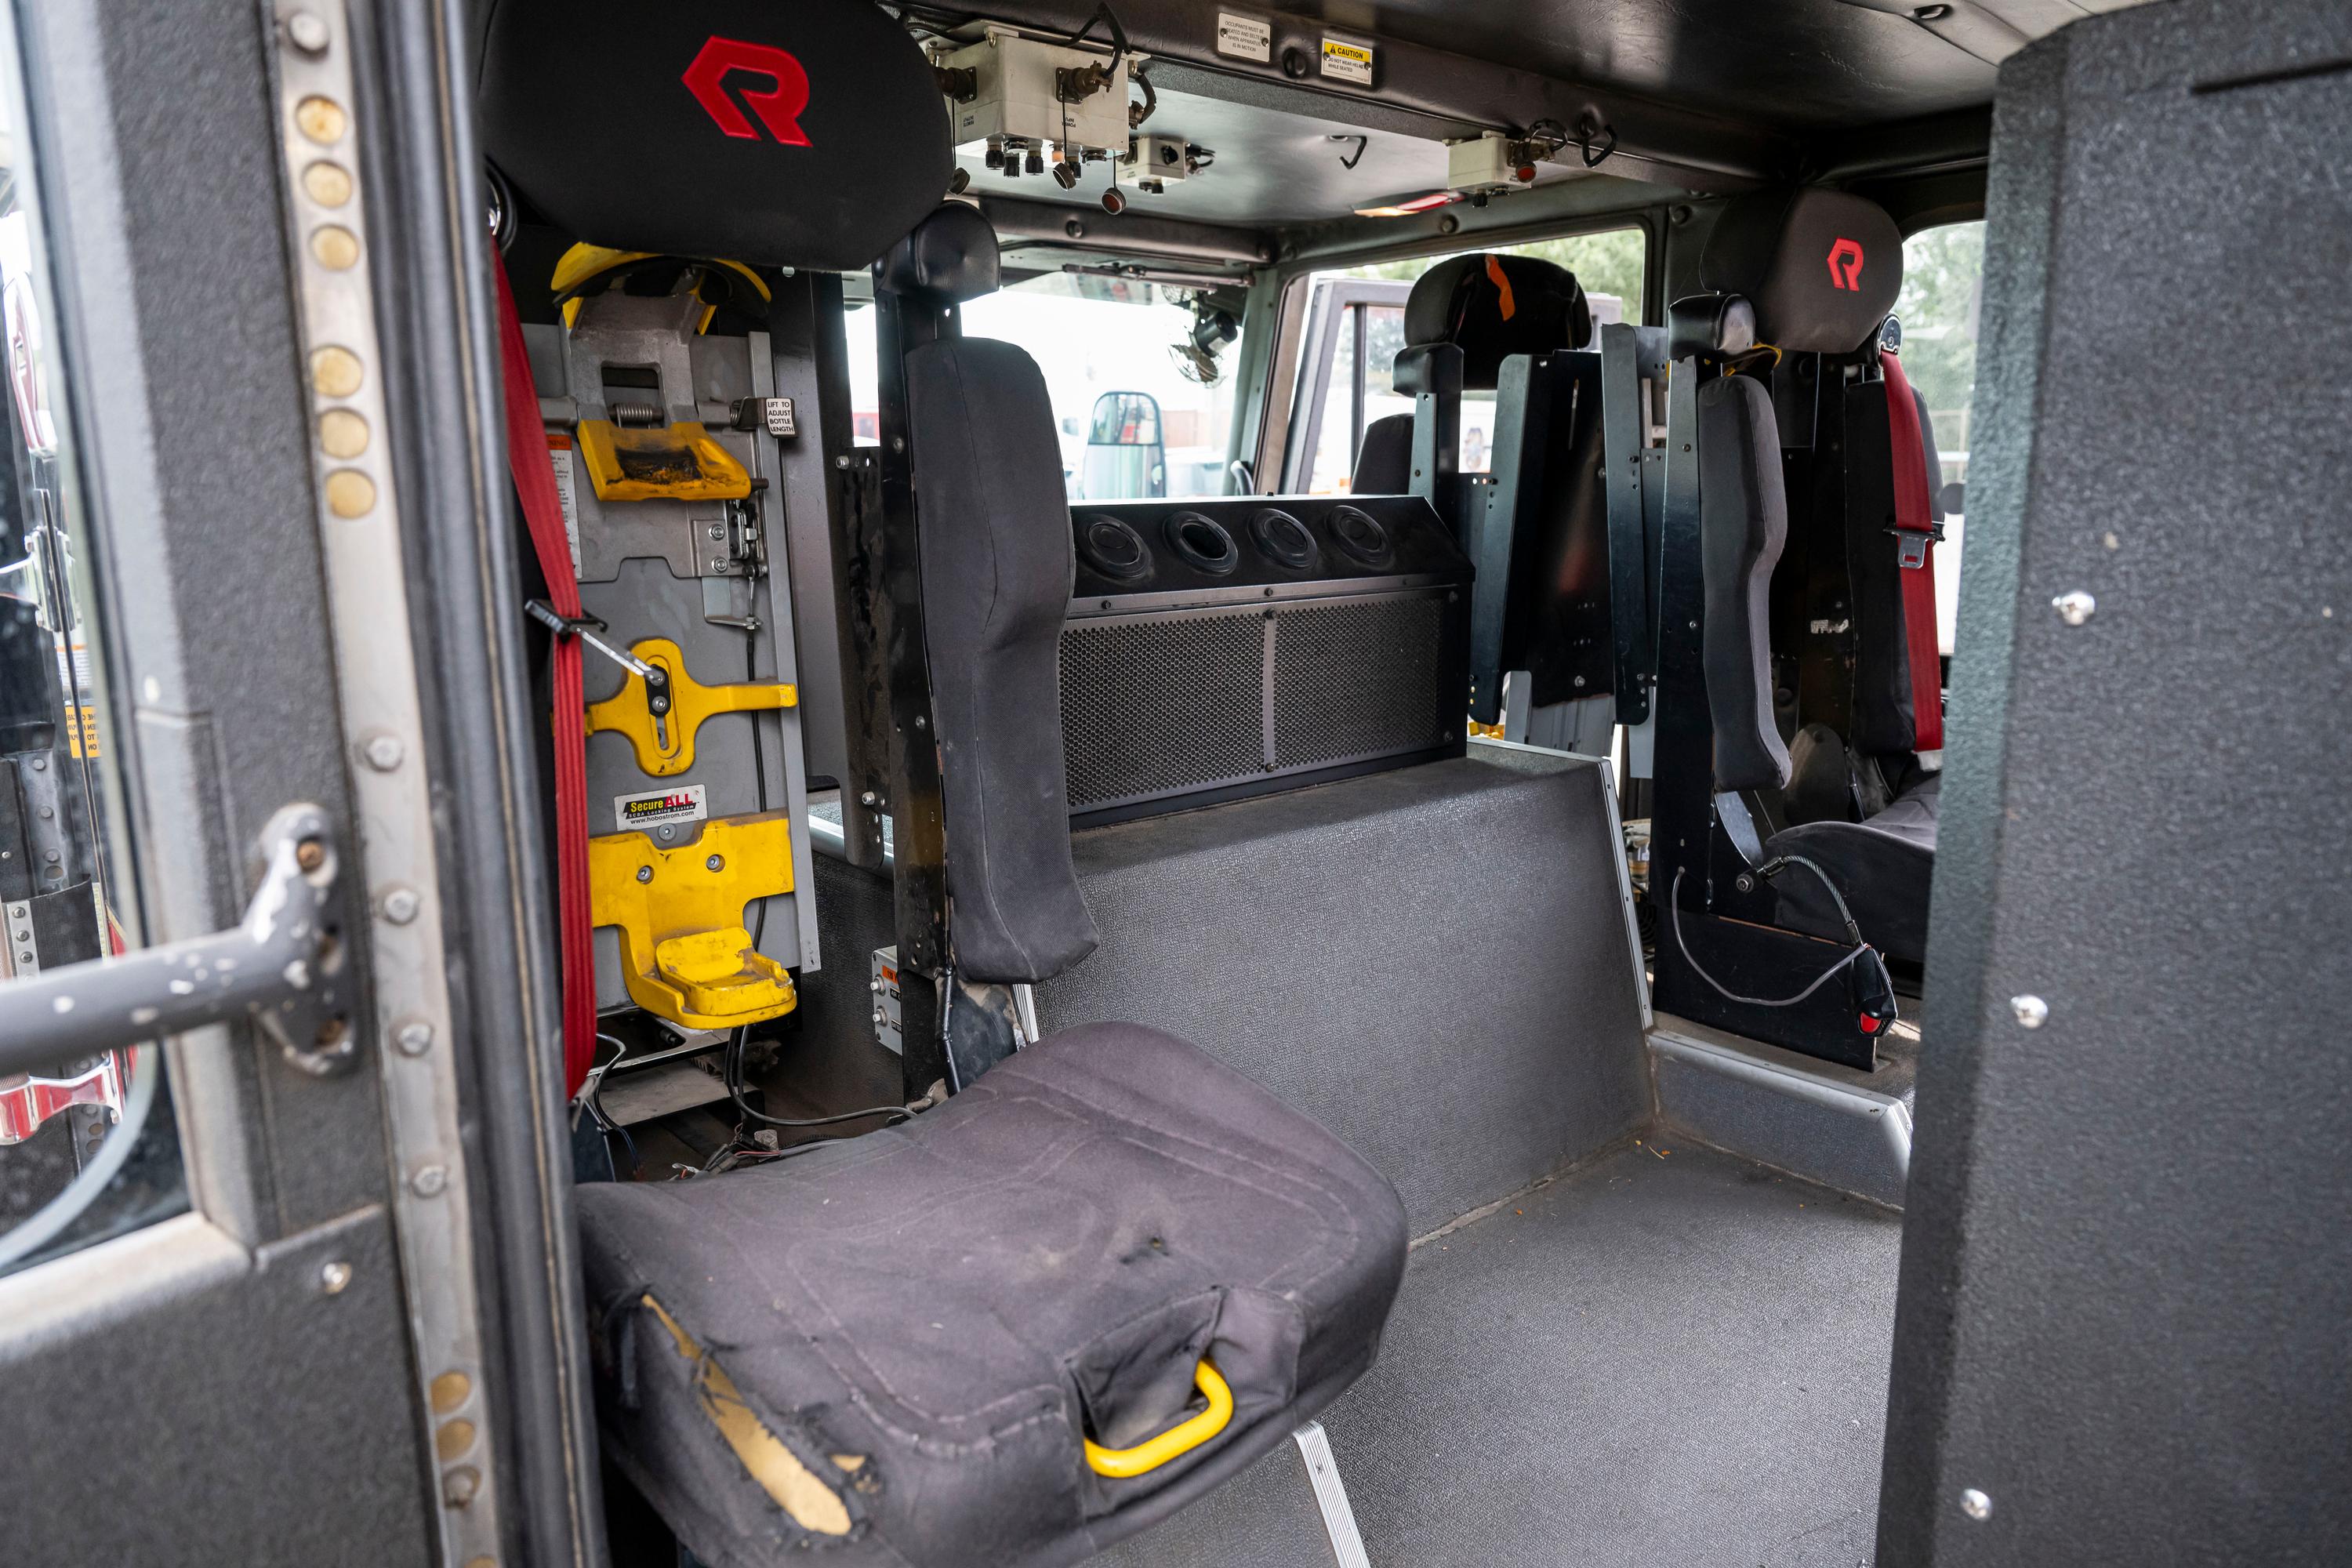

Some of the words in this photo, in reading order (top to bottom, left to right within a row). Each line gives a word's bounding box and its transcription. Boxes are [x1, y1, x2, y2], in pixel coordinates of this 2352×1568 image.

[1225, 20, 1247, 30] OCCUPANTS
[1240, 38, 1261, 46] APPARATUS
[1338, 47, 1363, 60] CAUTION
[630, 811, 695, 825] www.hobostrom.com
